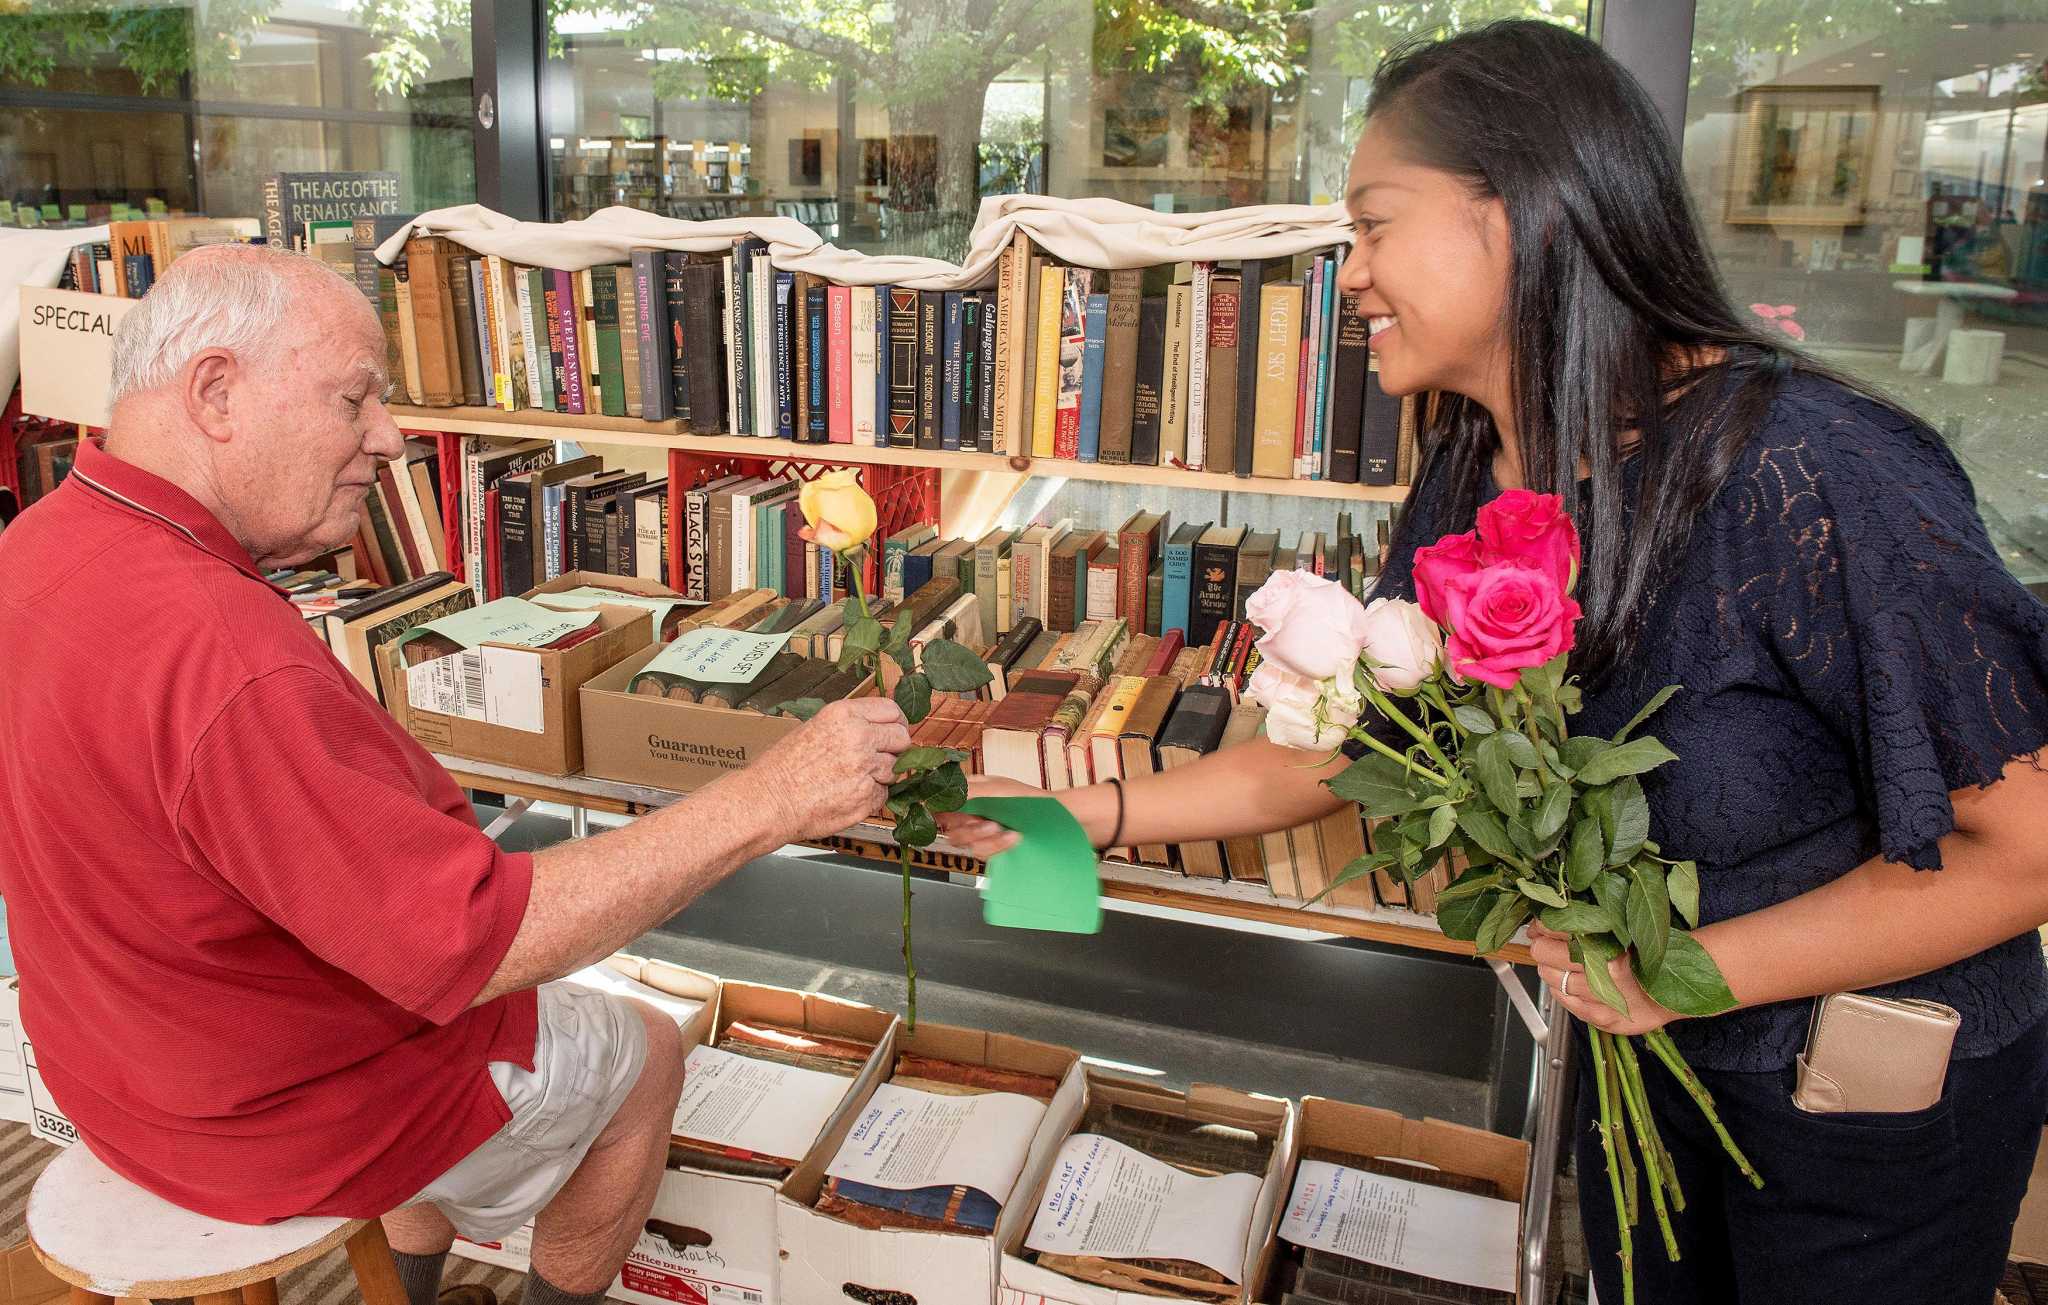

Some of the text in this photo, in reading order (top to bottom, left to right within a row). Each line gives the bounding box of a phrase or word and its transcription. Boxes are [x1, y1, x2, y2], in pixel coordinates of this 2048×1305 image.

[290, 180, 398, 199] THE AGE OF THE
[264, 179, 282, 238] THE AGE
[292, 201, 398, 222] RENAISSANCE
[1001, 254, 1011, 290] EARLY
[638, 276, 650, 342] HUNTING EVE
[733, 284, 741, 323] SEASONS
[833, 295, 844, 335] Dessen
[1112, 303, 1135, 312] Book
[1118, 313, 1126, 321] of
[545, 290, 557, 353] EVENT HORIZON
[924, 304, 934, 355] JOHN LESCROART
[982, 303, 995, 361] Galápagos
[998, 294, 1009, 356] AMERICAN
[1108, 318, 1139, 328] Marvels
[735, 332, 743, 371] AMERICA
[777, 323, 785, 371] PERSISTENCE
[1172, 341, 1180, 353] The
[1192, 272, 1206, 407] INDIAN HARBOR YACHT CLUB
[1266, 295, 1288, 382] NIGHT SKY
[563, 309, 580, 409] STEPPENWOLF
[924, 364, 933, 377] THE
[944, 359, 953, 382] DAYS
[951, 340, 960, 403] THE HUNDRED
[1172, 353, 1180, 366] End
[779, 373, 785, 384] OF
[924, 377, 933, 400] SECOND
[981, 364, 992, 419] Kurt Vonnegut
[996, 360, 1007, 401] DESIGN
[1170, 373, 1178, 403] Intelligent
[778, 385, 786, 407] MYTH
[1167, 403, 1177, 425] Writing
[491, 447, 553, 489] ANGERS
[508, 456, 522, 469] THE
[472, 516, 480, 557] AVENGERS
[551, 522, 560, 538] Says
[688, 502, 701, 550] BLACK
[552, 539, 561, 572] Elephants
[1207, 583, 1222, 592] The
[648, 734, 747, 761] Guaranteed
[649, 750, 668, 761] You
[670, 752, 696, 765] Have
[697, 756, 719, 767] Our
[628, 1251, 698, 1276] Office DEPOT
[654, 1240, 726, 1270] NICHOLAS
[627, 1265, 667, 1282] copy paper
